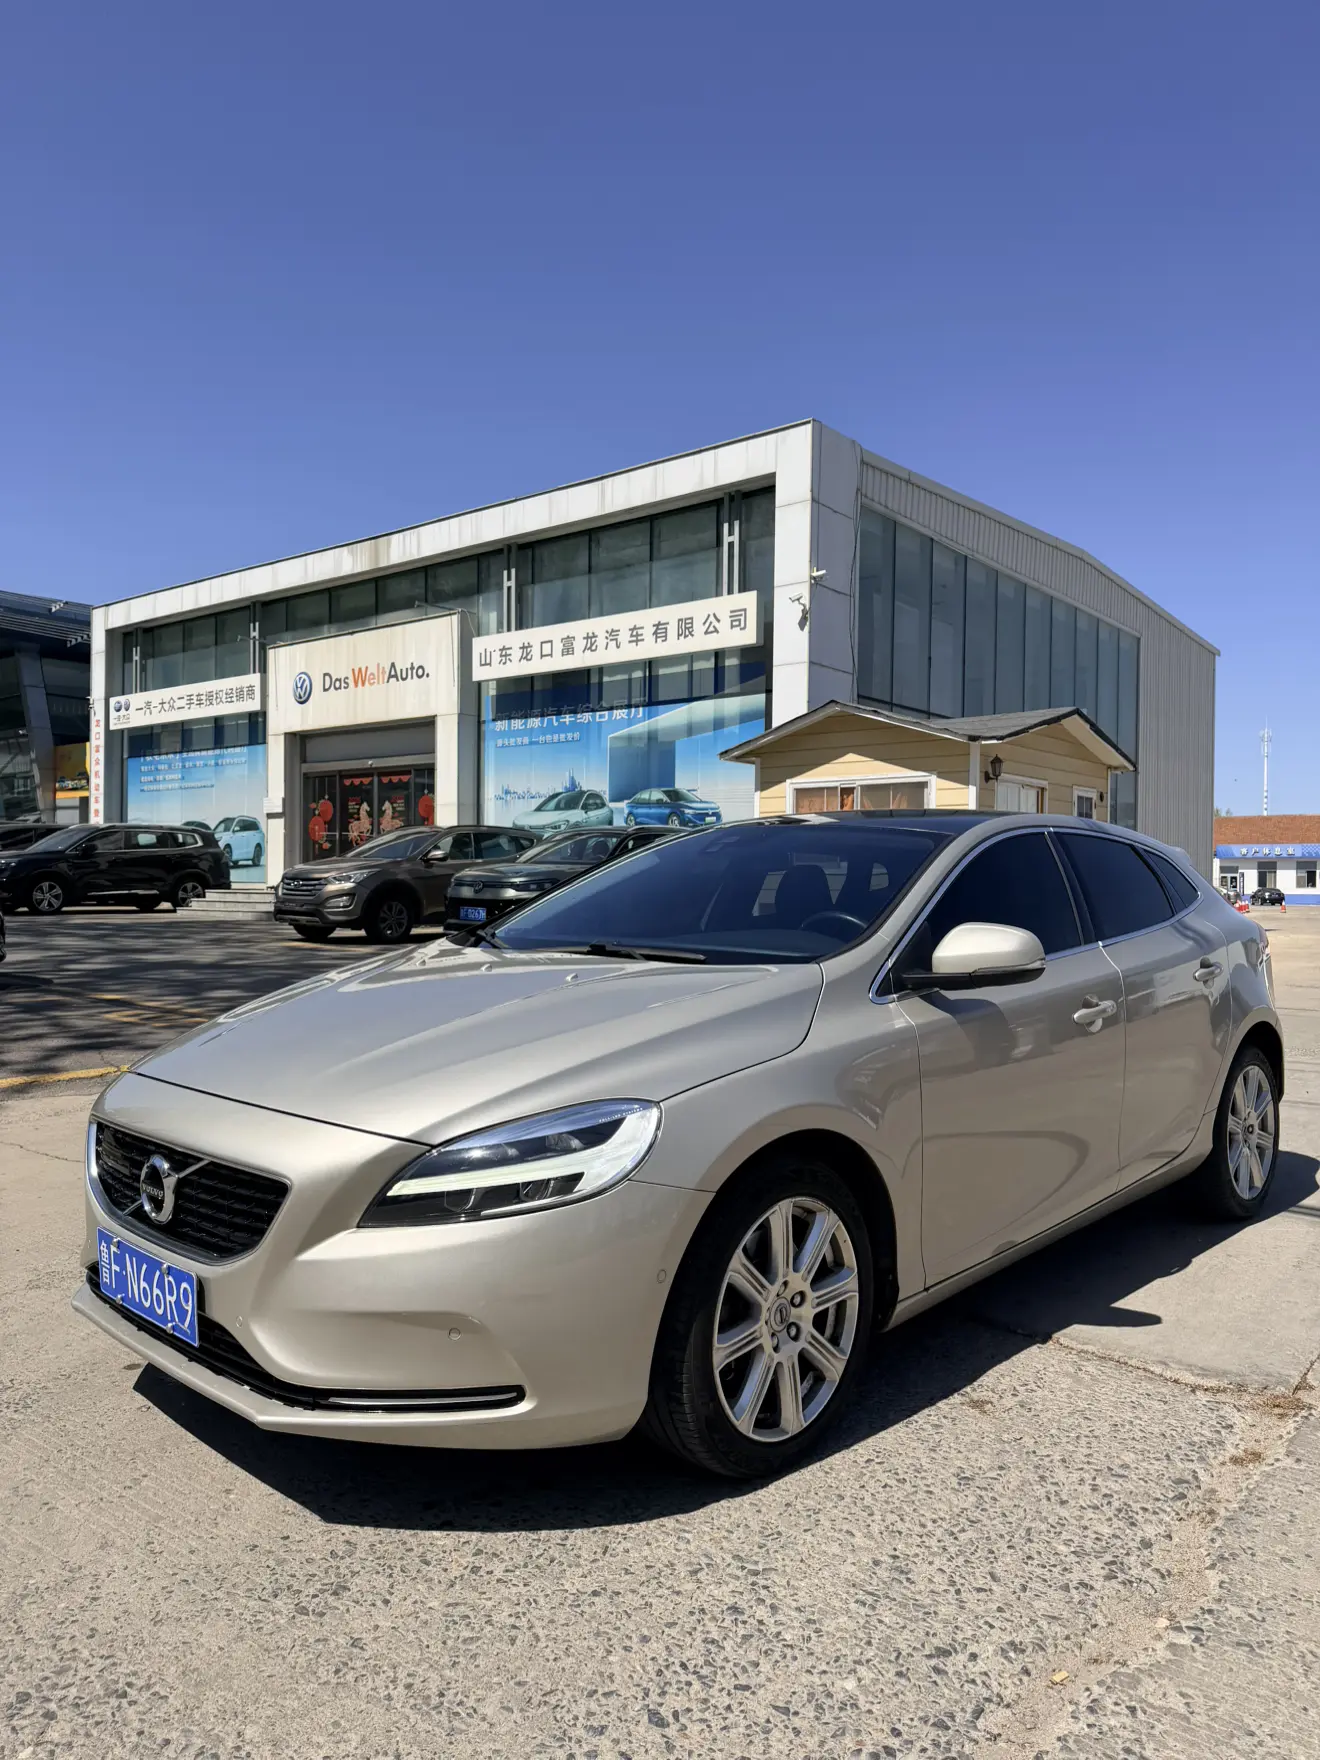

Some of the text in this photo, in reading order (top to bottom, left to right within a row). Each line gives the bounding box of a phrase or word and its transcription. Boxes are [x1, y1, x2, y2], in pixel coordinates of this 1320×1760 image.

[478, 607, 748, 668] 山东龙口富龙汽车有限公司
[322, 672, 350, 692] Das
[494, 699, 644, 732] 新能源汽车综合展厅
